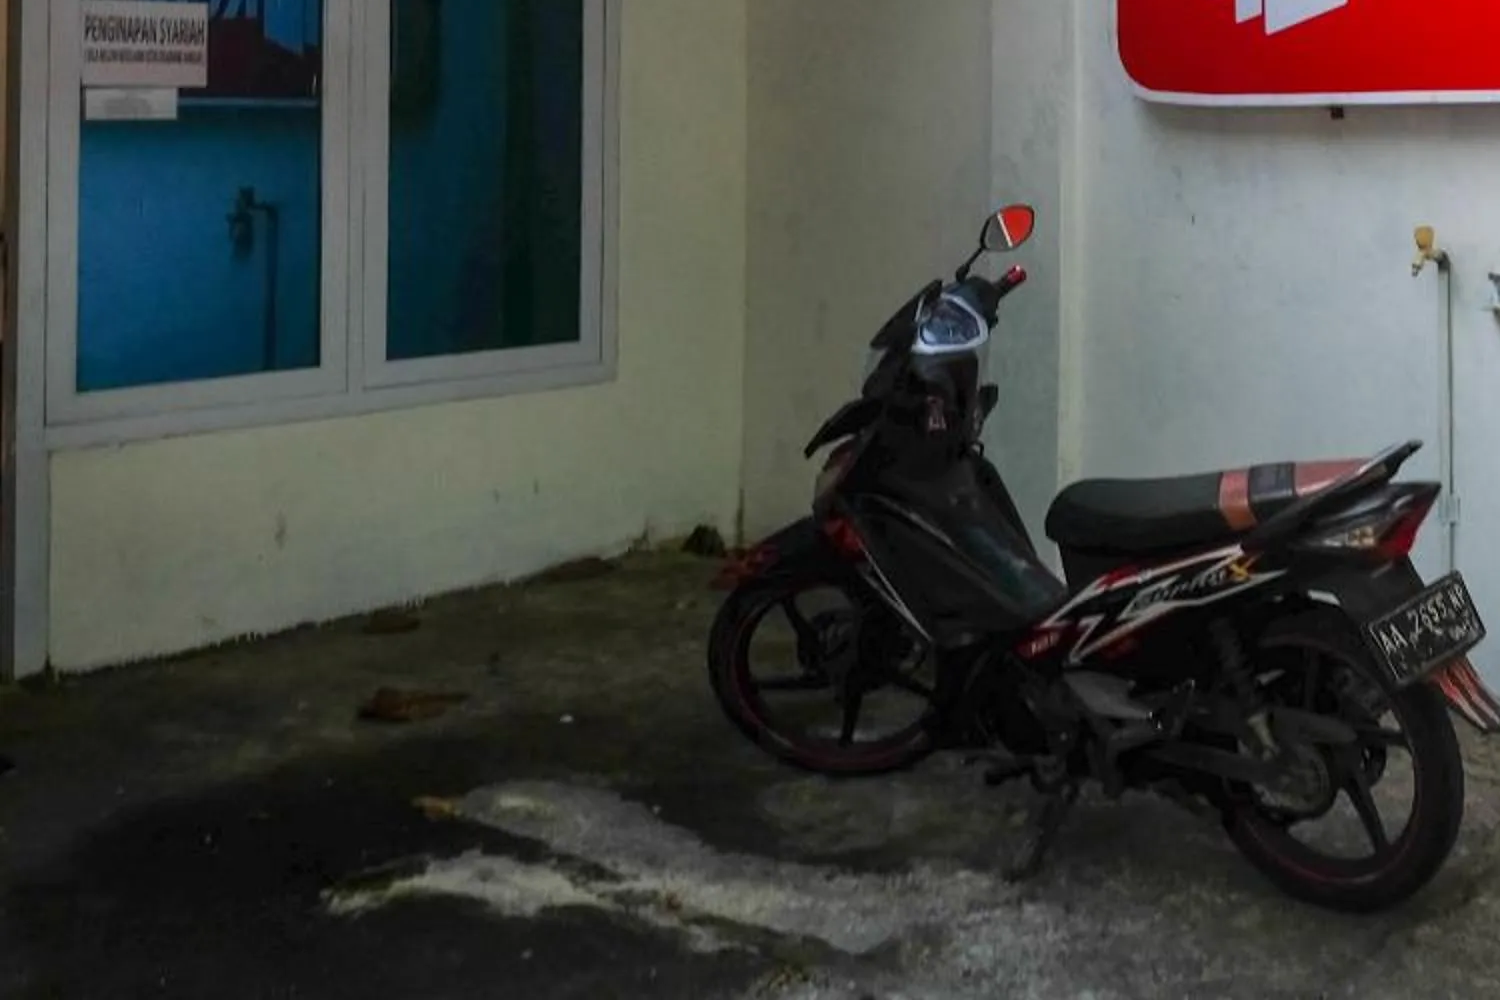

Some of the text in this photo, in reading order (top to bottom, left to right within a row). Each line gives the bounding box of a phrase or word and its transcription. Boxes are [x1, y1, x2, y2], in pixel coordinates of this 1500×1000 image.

[84, 14, 206, 46] PENGINAPAN SYARIAH
[1379, 622, 1409, 658] AA
